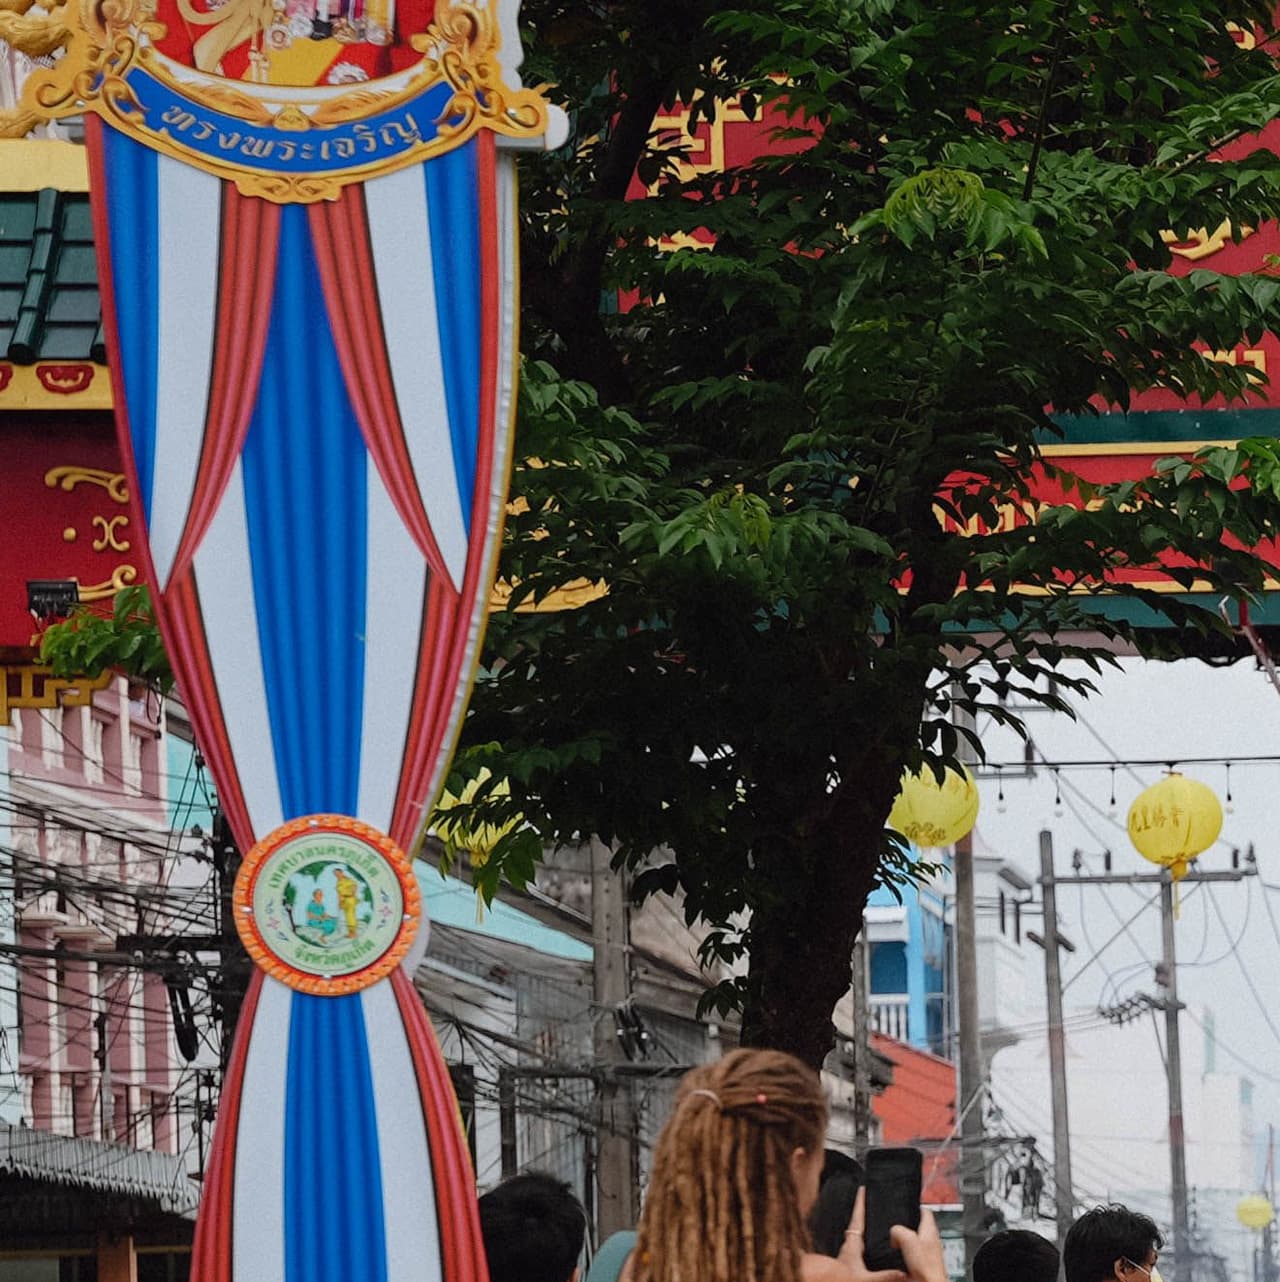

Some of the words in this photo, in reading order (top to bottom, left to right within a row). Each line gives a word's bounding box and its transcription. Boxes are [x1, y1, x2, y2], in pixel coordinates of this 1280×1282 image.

[159, 104, 424, 161] ทรงพระเจริญ
